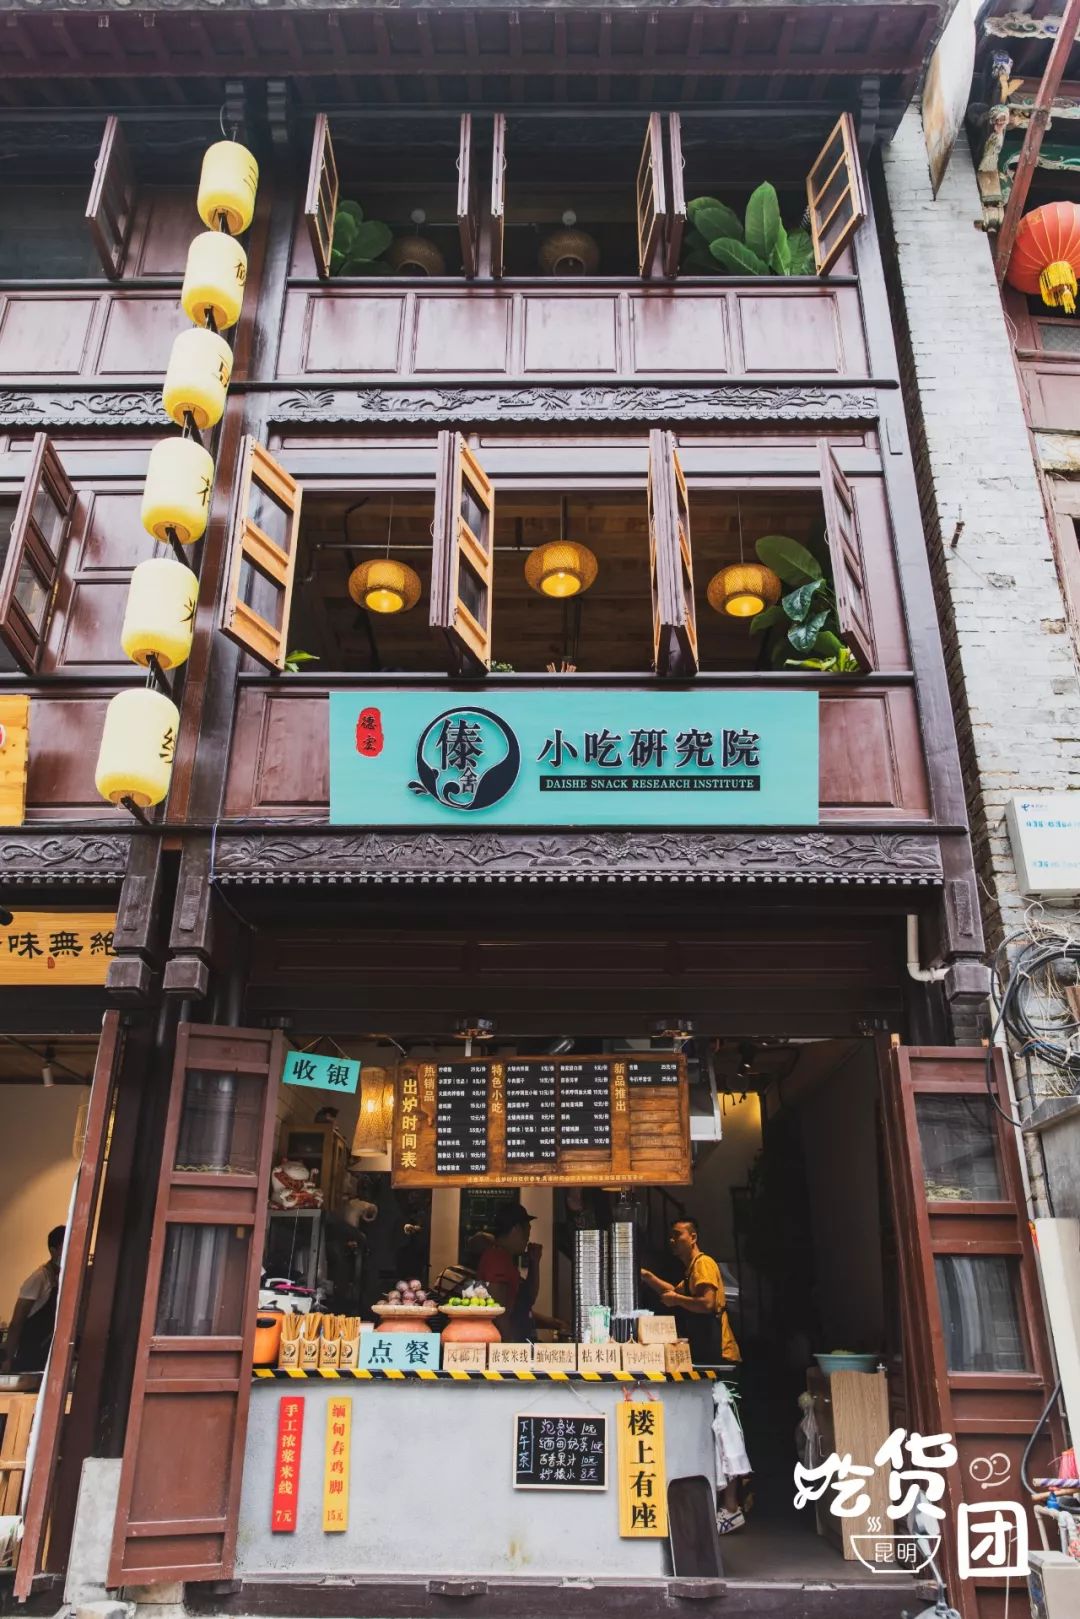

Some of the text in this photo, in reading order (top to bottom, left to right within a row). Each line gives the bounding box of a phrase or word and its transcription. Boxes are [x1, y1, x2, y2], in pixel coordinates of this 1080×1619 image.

[537, 728, 761, 769] 小吃研究院
[546, 779, 755, 789] DAISHE SNACK RESEARCH INSTITUTE
[293, 1058, 350, 1087] 收银
[423, 1065, 435, 1102] 热销品
[491, 1064, 503, 1113] 特色小吃
[614, 1062, 627, 1113] 新品推出
[401, 1078, 418, 1169] 出炉时间表
[367, 1337, 431, 1365] 点餐
[581, 1348, 617, 1364] 粘米团
[278, 1403, 299, 1495] 手工浓浆米线
[519, 1420, 531, 1468] 下午茶
[538, 1437, 589, 1452] 缅甸奶茶
[539, 1453, 598, 1468] 百香果汁 10元
[539, 1468, 598, 1481] 柠檬水 8元
[627, 1408, 658, 1530] 楼上有座
[275, 1509, 292, 1523] 7元
